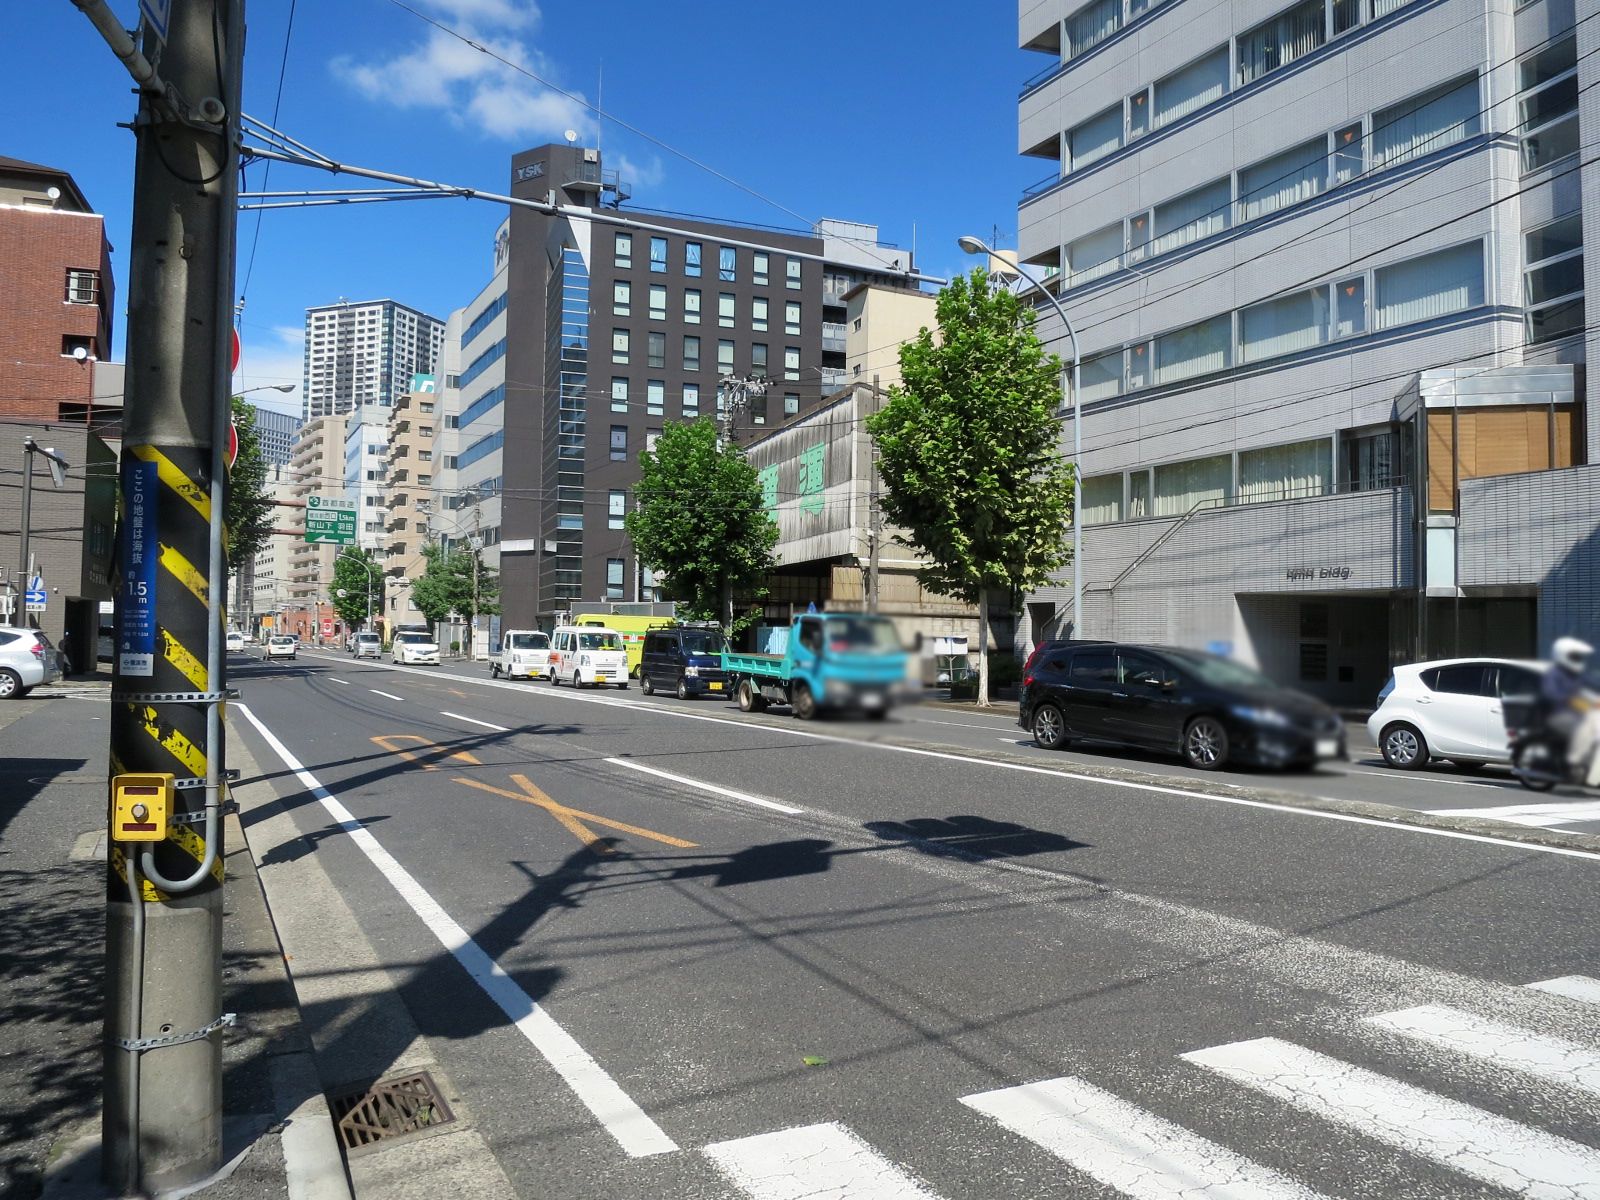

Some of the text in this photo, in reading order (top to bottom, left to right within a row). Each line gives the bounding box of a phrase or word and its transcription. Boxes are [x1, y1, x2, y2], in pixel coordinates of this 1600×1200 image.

[517, 163, 544, 180] YSK
[133, 469, 144, 564] ここの地盤は海抜
[127, 581, 147, 596] 1.5
